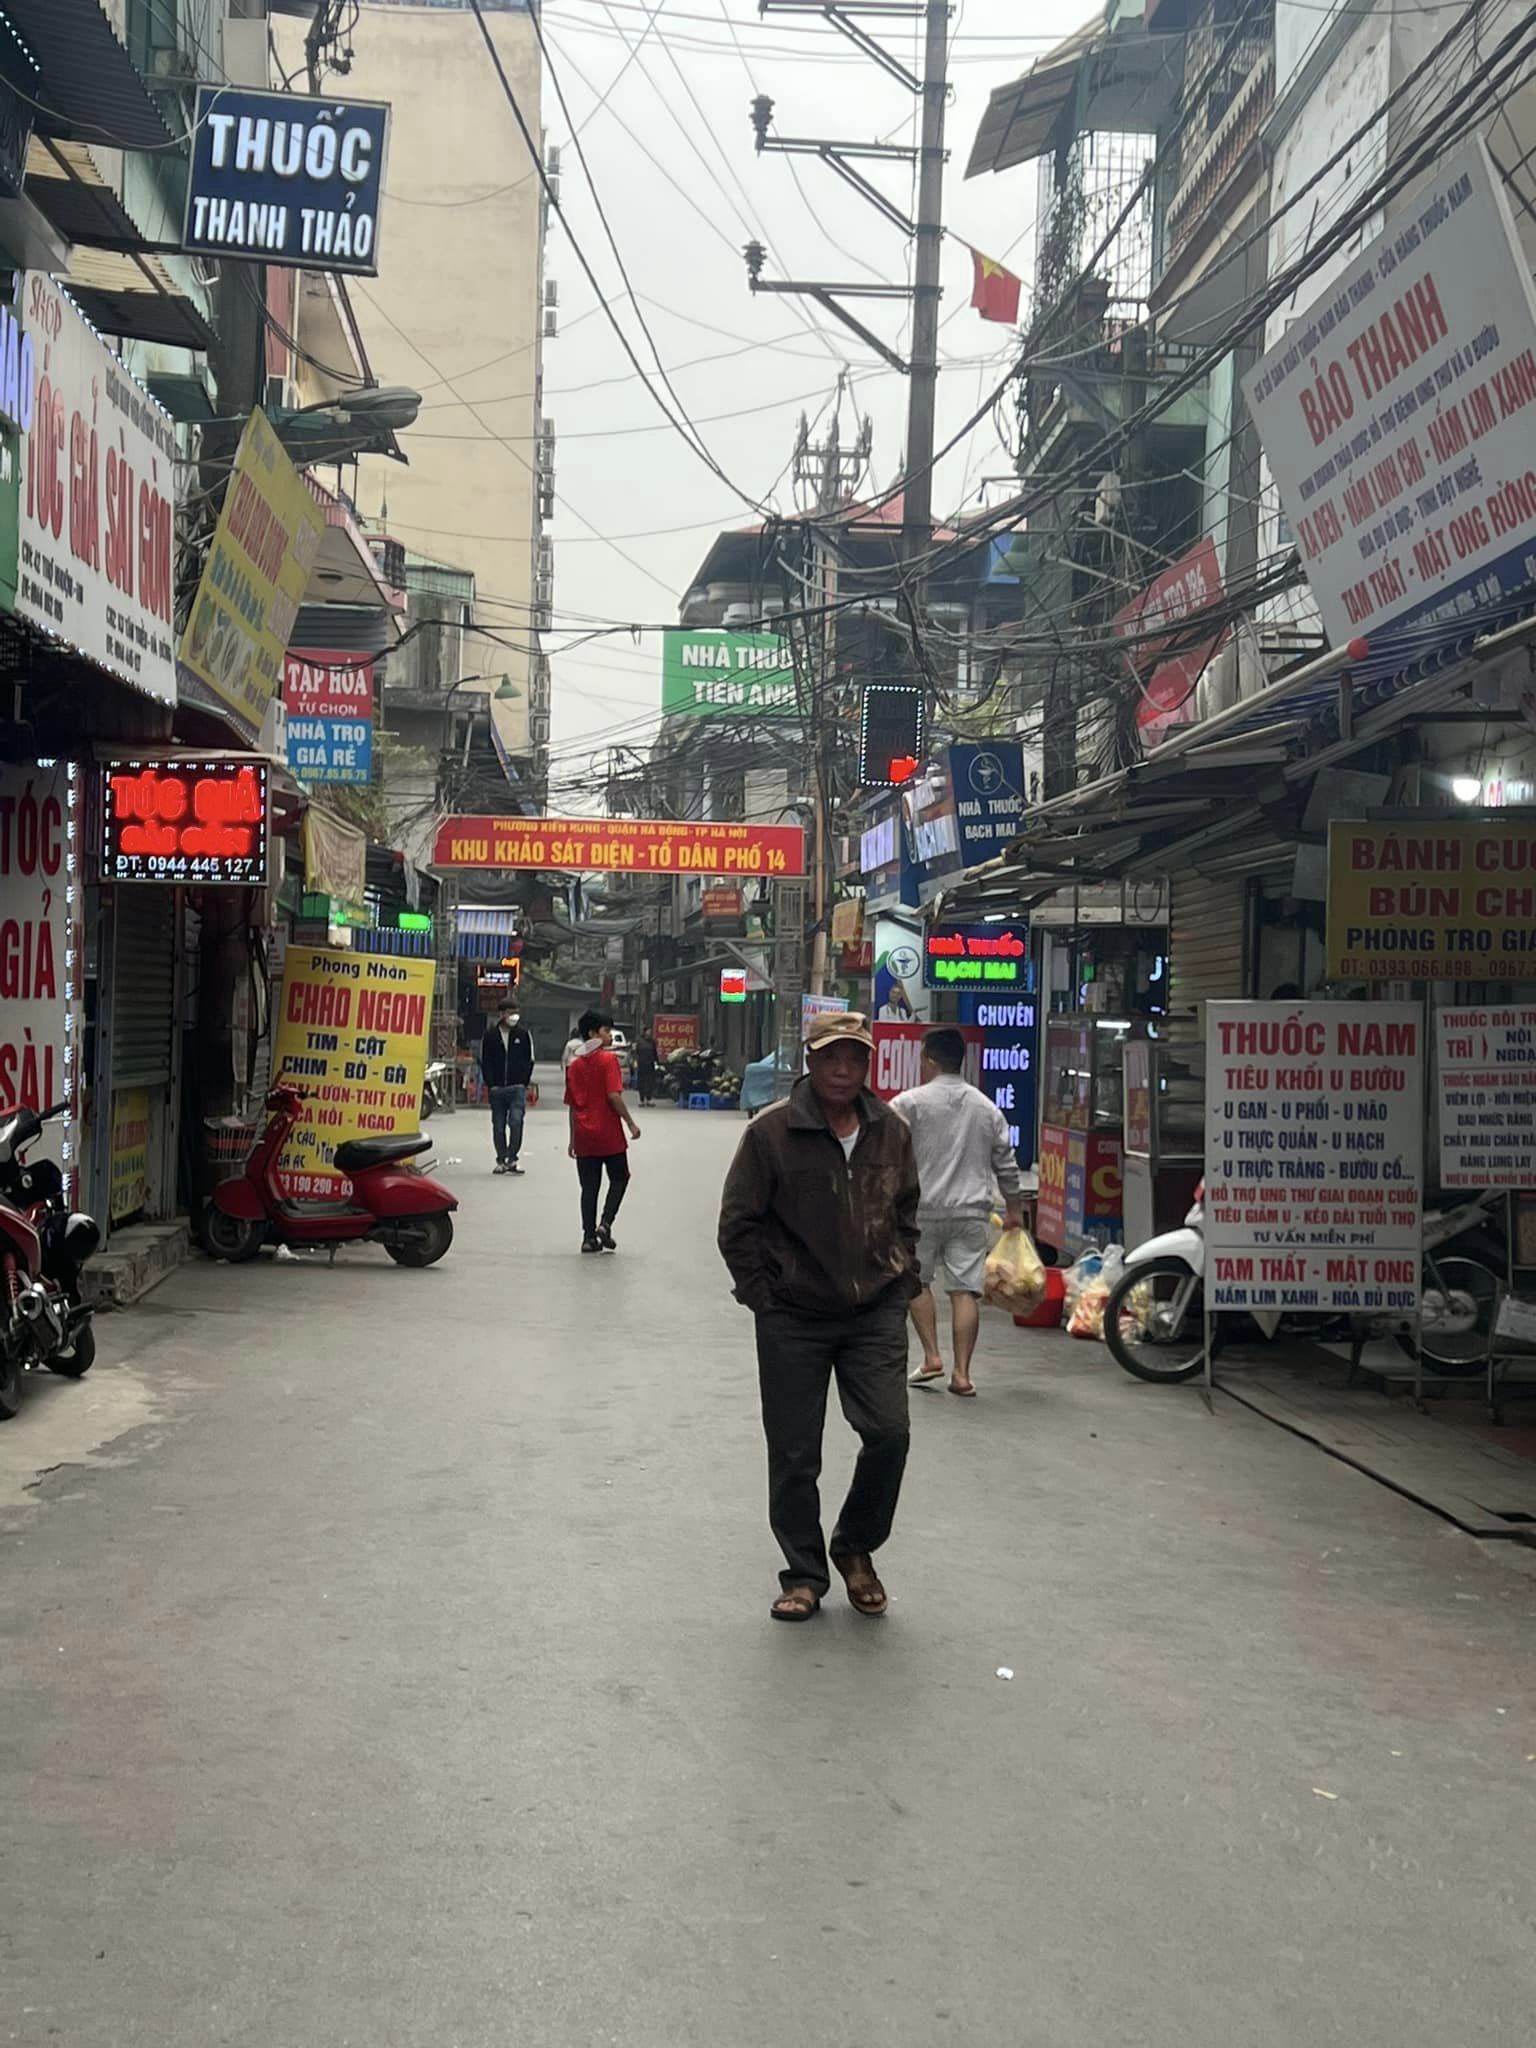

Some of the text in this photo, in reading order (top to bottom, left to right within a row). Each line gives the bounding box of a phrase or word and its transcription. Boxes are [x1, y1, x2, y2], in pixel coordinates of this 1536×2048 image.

[208, 106, 372, 181] THUỐC
[194, 191, 373, 257] THANH THẢO
[1300, 272, 1448, 446] BẢO THANH
[1397, 437, 1426, 488] CHI
[1462, 383, 1497, 440] LIM
[1490, 348, 1536, 420] XANH
[70, 375, 100, 573] GIẢ
[105, 426, 134, 598] SÀI
[139, 456, 171, 625] GÒN
[1341, 580, 1374, 625] TAM
[1368, 547, 1407, 608] THẤT
[1412, 527, 1452, 582] MẬT
[1449, 505, 1490, 559] ONG
[1486, 471, 1536, 538] RỪNG
[682, 641, 731, 668] NHÀ
[288, 663, 325, 700] TẠP
[748, 683, 798, 706] ANH
[298, 702, 358, 716] TỰ CHỌN
[288, 720, 366, 746] NHÀ TRỌ
[297, 744, 356, 766] GIÁ RẺ
[111, 770, 186, 820] TÓC
[958, 798, 982, 816] NHÀ
[0, 780, 61, 876] TÓC
[695, 827, 708, 838] TP
[116, 855, 253, 874] ĐT: 0944 445 127
[451, 833, 786, 871] KHU KHẢO SÁT ĐIỆN TỔ DÂN PHỐ 14
[1351, 832, 1461, 871] BÁNH
[1370, 881, 1460, 917] BÚN
[0, 888, 56, 1000] GIẢ
[1346, 923, 1492, 958] PHÒNG TRỌ
[311, 956, 360, 979] Phong
[984, 962, 1016, 980] MAI
[286, 978, 427, 1036] CHÁO NGON
[978, 1001, 1034, 1027] CHUYÊN
[306, 1031, 387, 1061] TIM CẬT
[1218, 1010, 1416, 1057] THUỐC NAM
[1507, 1030, 1532, 1047] NỘI
[281, 1055, 407, 1085] CHIM BÒ GÀ
[877, 1034, 921, 1090] CƠM
[982, 1043, 1029, 1070] THUỐC
[1225, 1061, 1405, 1091] TIÊU KHỐI U BƯỚU
[995, 1083, 1015, 1109] KÊ
[1224, 1100, 1387, 1121] U GAN U U NÃO
[357, 1112, 395, 1132] NGAO
[1224, 1125, 1384, 1155] U THỰC QUẢN U HẠCH
[1223, 1160, 1233, 1178] U
[1238, 1160, 1273, 1184] TRỰC
[1304, 1208, 1328, 1224] KÉO
[1274, 1227, 1305, 1243] VẤN
[1311, 1227, 1345, 1244] MIỄN
[1350, 1230, 1374, 1244] PHÍ
[1214, 1250, 1414, 1286] TAM THẤT MẬT ONG
[1214, 1284, 1247, 1304] NẤM
[1251, 1289, 1277, 1304] LIM
[1281, 1289, 1318, 1306] XANH
[1333, 1290, 1360, 1306] HOA
